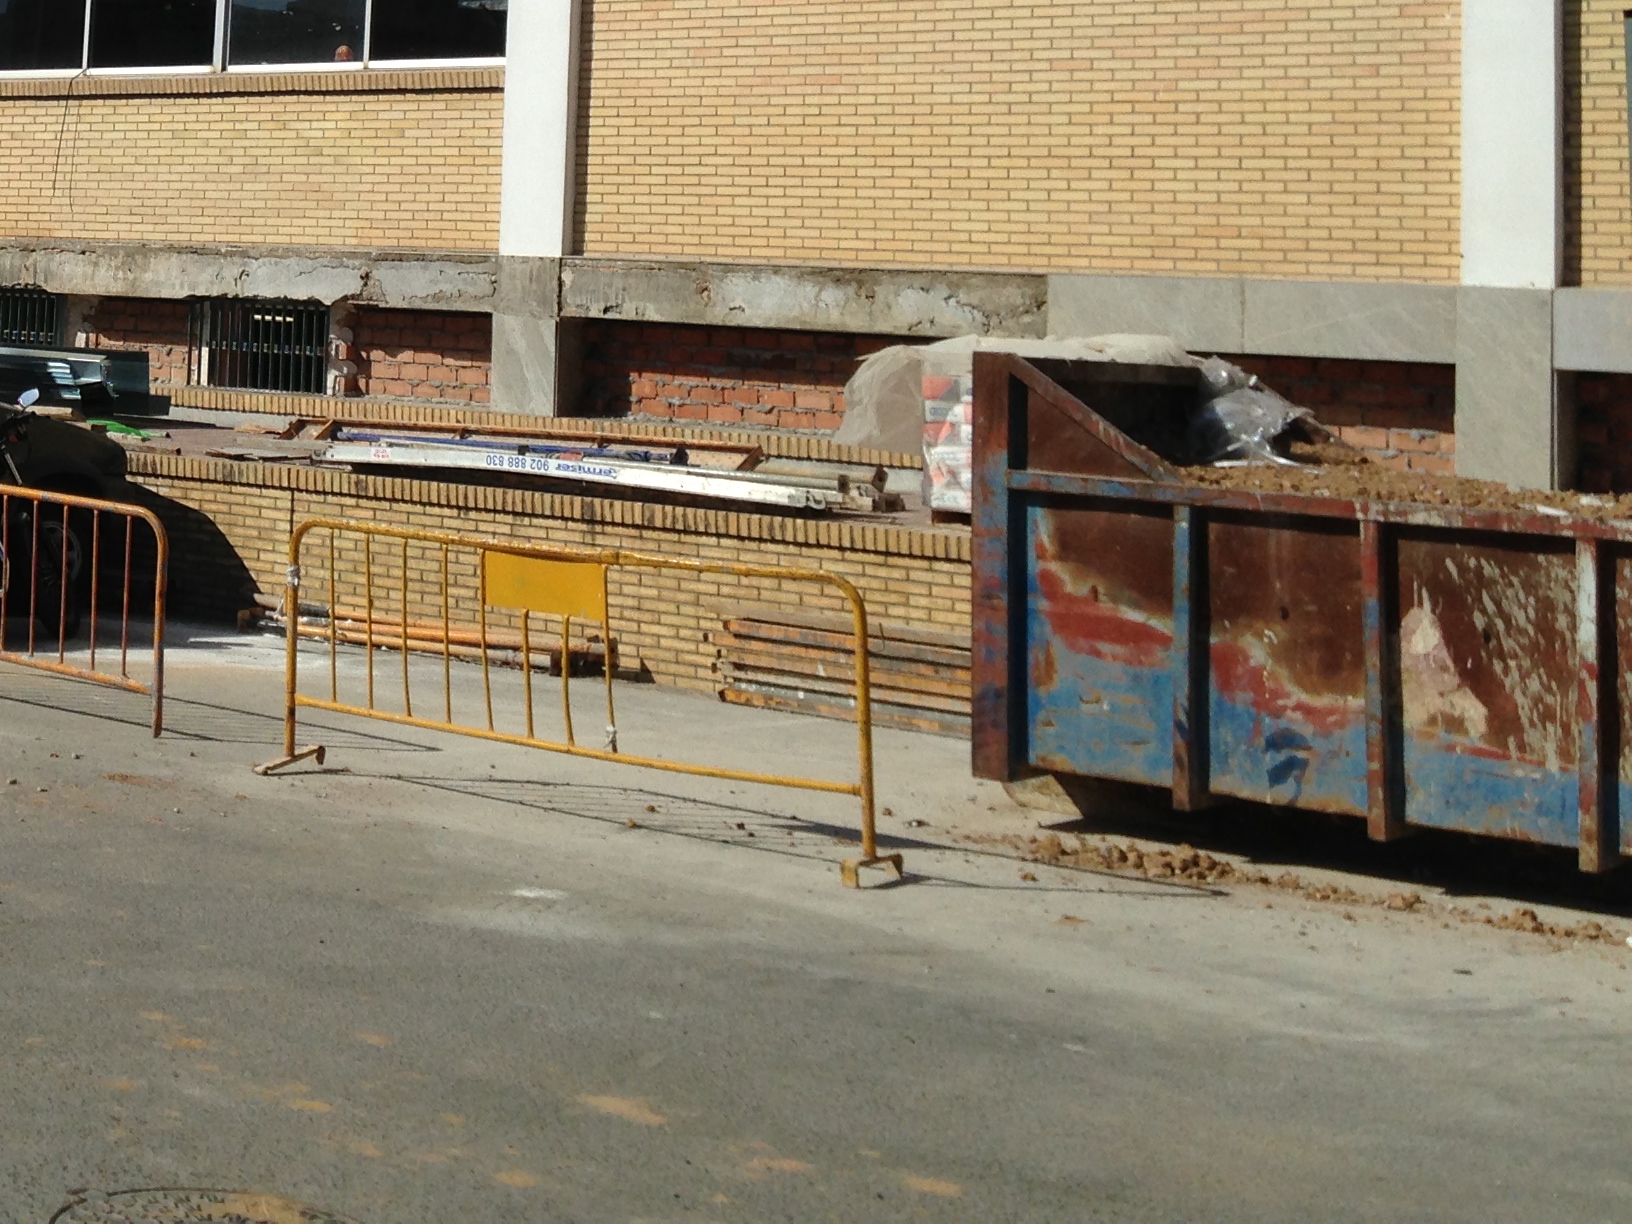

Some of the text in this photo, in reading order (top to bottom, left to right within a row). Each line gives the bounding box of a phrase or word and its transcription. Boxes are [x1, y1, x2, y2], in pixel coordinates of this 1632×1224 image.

[486, 454, 504, 466] 830
[507, 456, 527, 468] 888
[530, 458, 549, 471] 902
